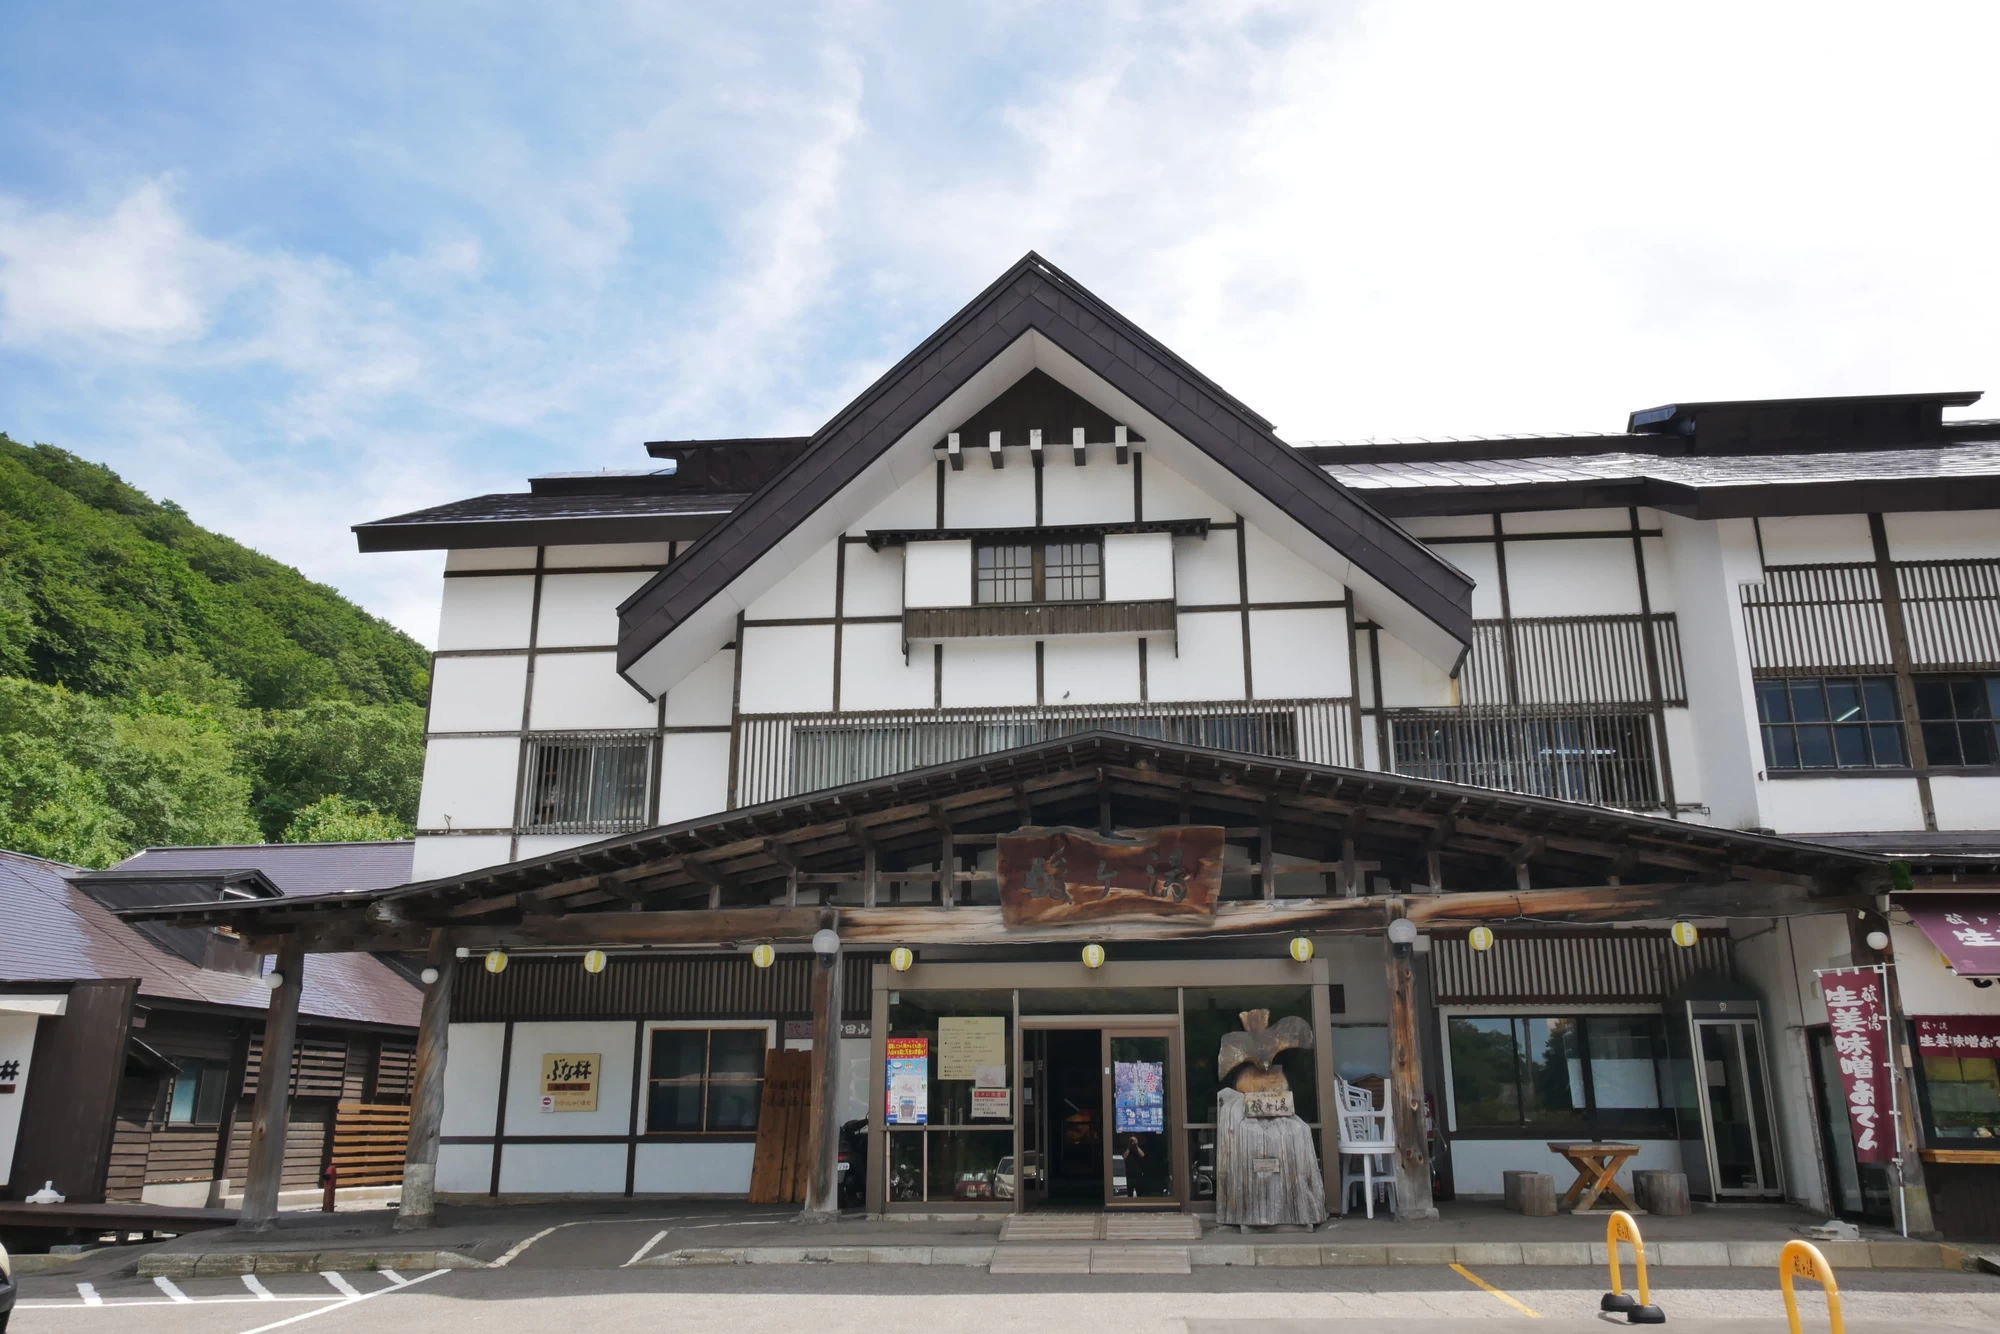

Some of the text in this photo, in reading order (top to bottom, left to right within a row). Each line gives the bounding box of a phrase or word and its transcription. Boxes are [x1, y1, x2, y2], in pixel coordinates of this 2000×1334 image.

[840, 1023, 870, 1035] 田山
[546, 1058, 592, 1081] ぶな林
[1825, 985, 1878, 1151] 生姜味噌おでん
